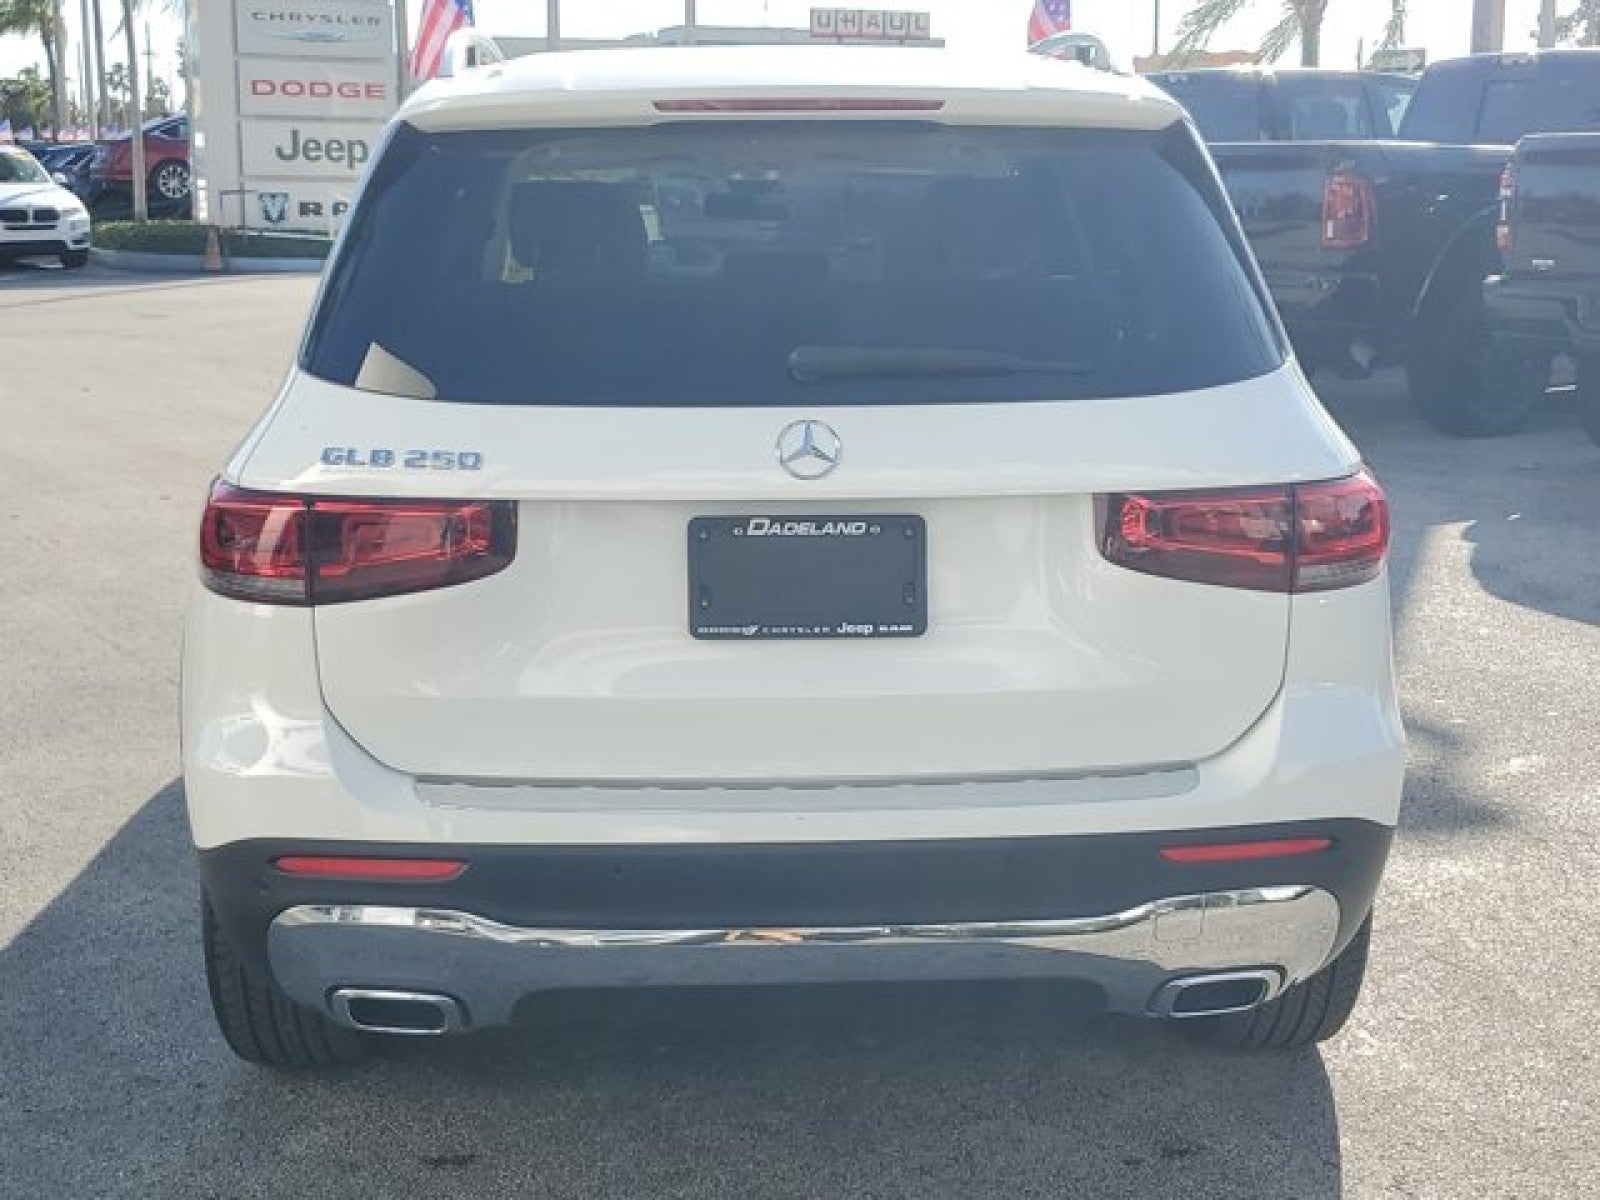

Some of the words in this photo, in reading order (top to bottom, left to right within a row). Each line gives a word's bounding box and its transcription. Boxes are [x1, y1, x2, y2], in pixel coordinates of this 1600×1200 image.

[251, 80, 386, 98] DODGE
[275, 129, 369, 170] Jeep
[299, 201, 349, 217] RA
[320, 447, 395, 467] GLB
[404, 450, 481, 470] 250
